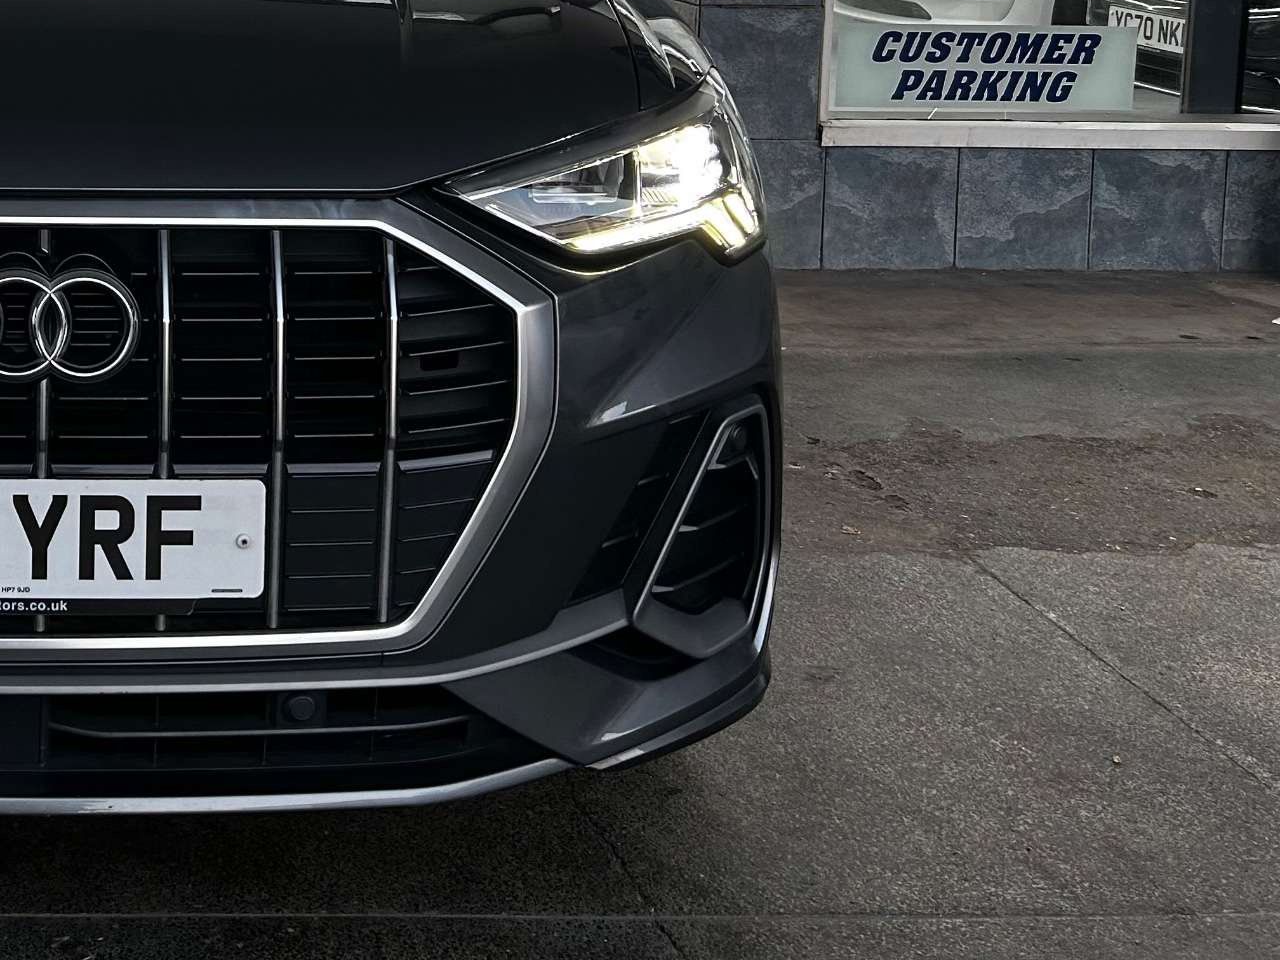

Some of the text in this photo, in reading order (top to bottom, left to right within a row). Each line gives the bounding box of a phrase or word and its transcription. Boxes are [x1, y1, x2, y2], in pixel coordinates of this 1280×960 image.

[872, 31, 1102, 65] CUSTOMER
[890, 70, 1078, 103] PARKING
[12, 494, 202, 581] YRF
